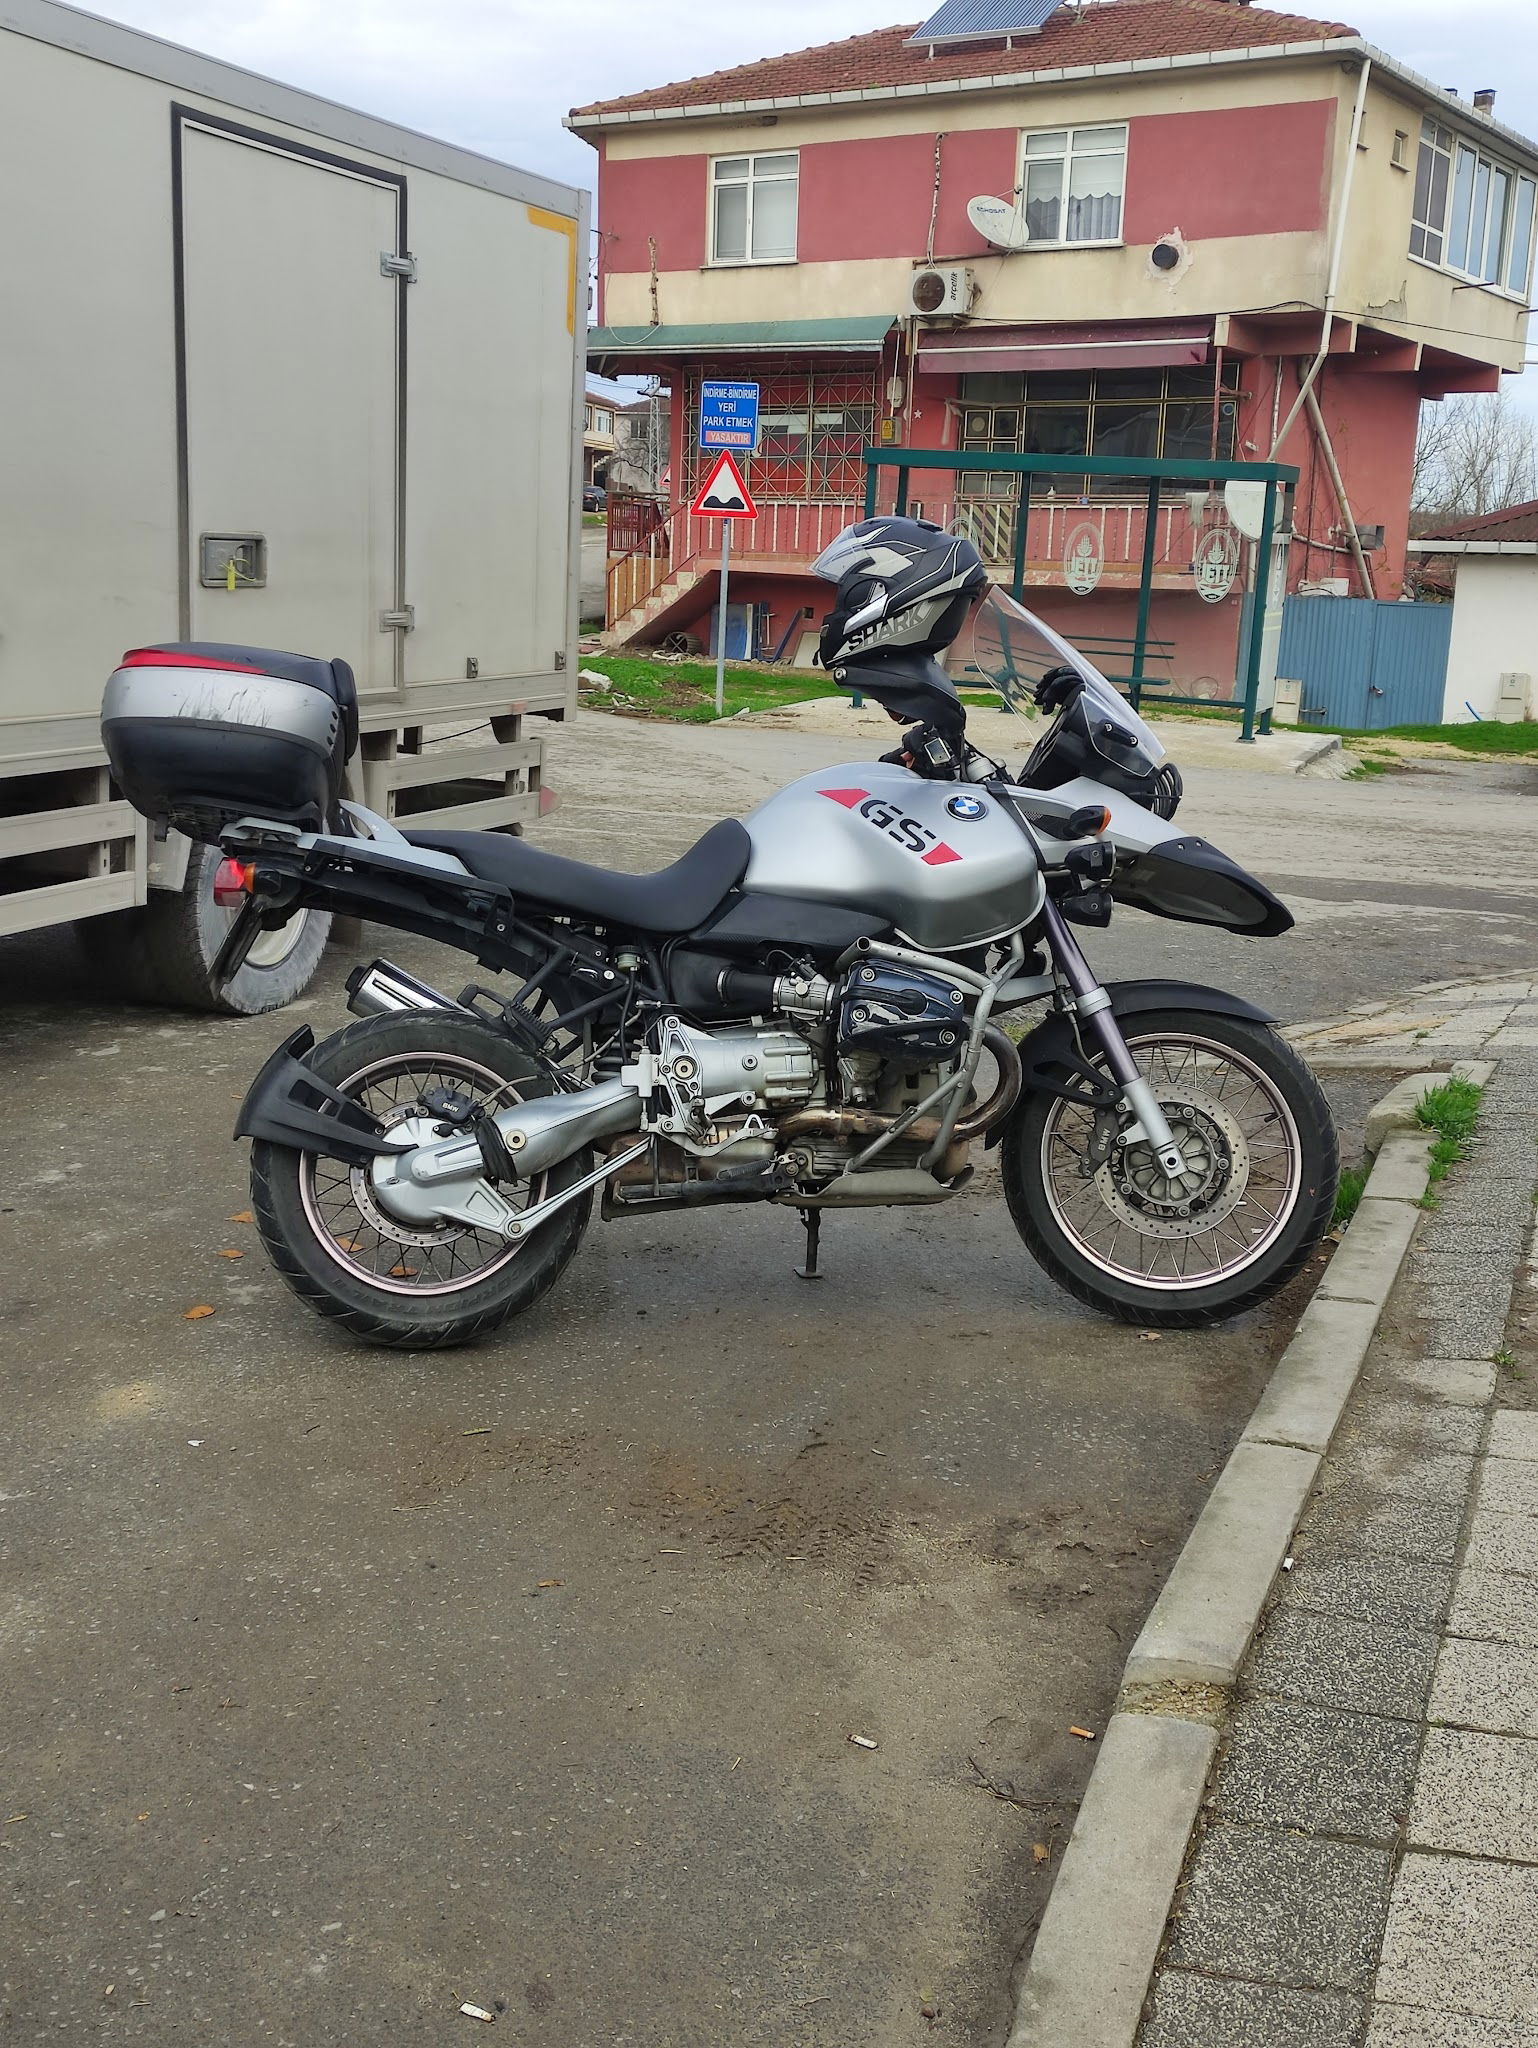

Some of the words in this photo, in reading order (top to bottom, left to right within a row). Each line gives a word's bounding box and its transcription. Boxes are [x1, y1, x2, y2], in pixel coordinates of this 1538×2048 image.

[718, 400, 737, 413] YERİ
[703, 415, 725, 426] PARK
[725, 416, 753, 428] ETMEK
[711, 431, 749, 444] YASAKTIR
[848, 602, 923, 652] SHARK
[860, 799, 937, 852] GS
[442, 1102, 459, 1113] BMW
[1097, 1127, 1111, 1151] BMW
